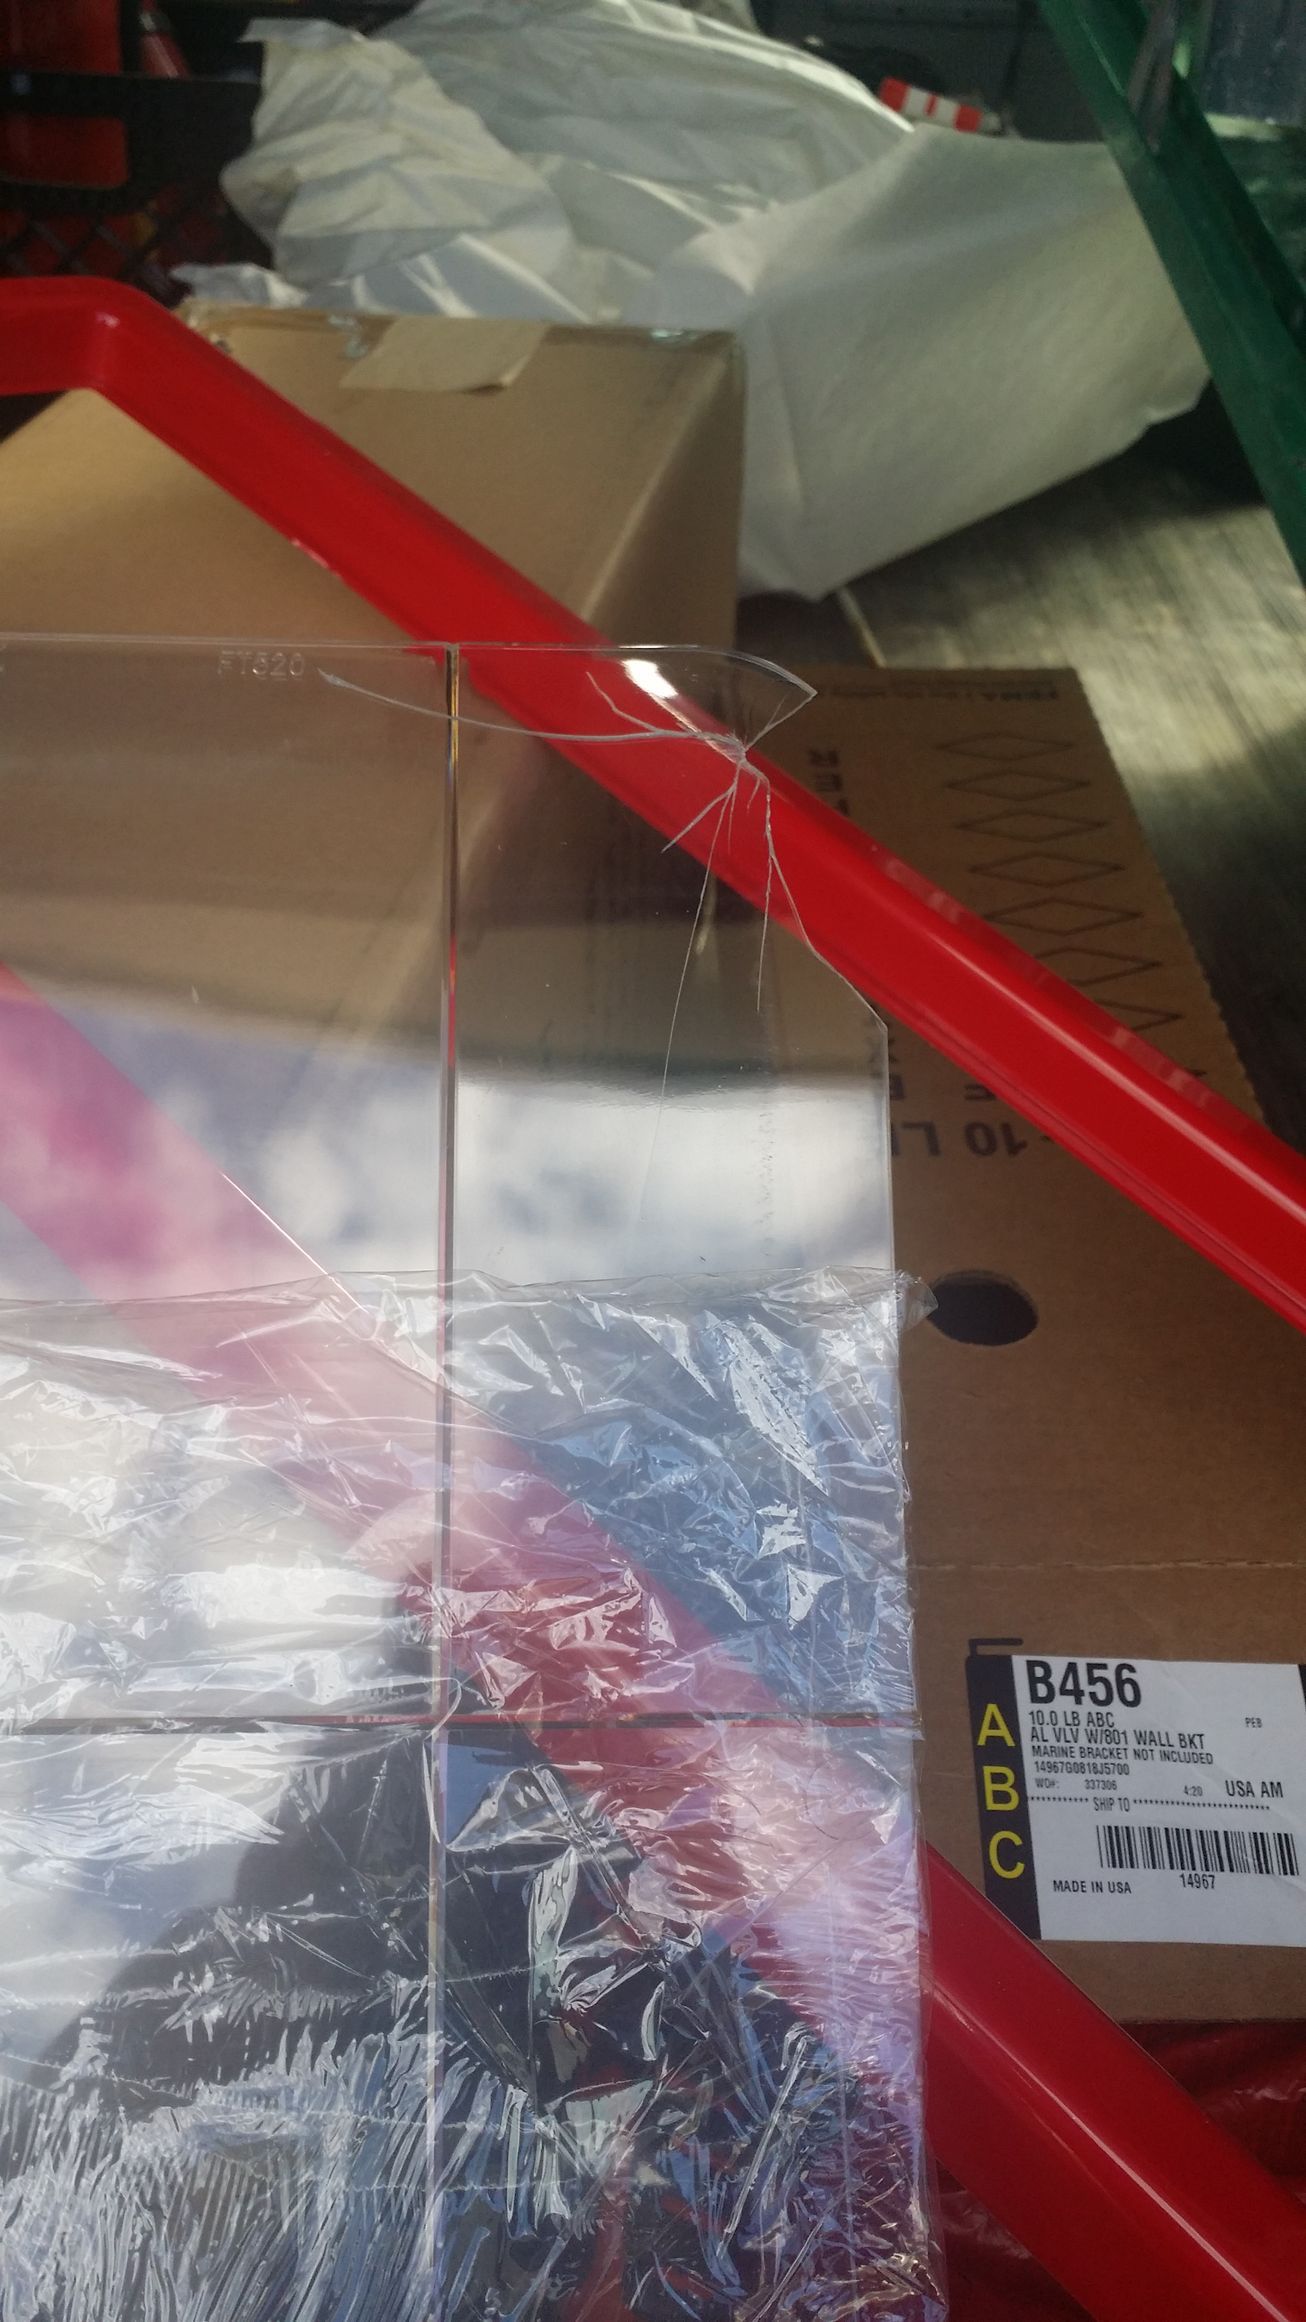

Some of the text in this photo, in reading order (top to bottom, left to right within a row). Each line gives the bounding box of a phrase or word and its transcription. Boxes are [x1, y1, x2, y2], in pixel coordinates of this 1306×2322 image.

[1026, 1659, 1141, 1708] B456
[977, 1703, 1016, 1747] A
[1029, 1710, 1115, 1728] 10.0 LB ABC
[1031, 1726, 1205, 1749] AL VLV W/801 WALL BKT
[1031, 1745, 1213, 1765] MARINE BRACKET NOT INCLUDED
[982, 1765, 1019, 1811] B
[1225, 1780, 1255, 1797] USA
[1260, 1781, 1283, 1798] AM
[1093, 1796, 1130, 1812] SHIP TO
[988, 1830, 1026, 1879] C
[1053, 1880, 1132, 1894] MADE IN USA
[1180, 1873, 1216, 1889] 14967
